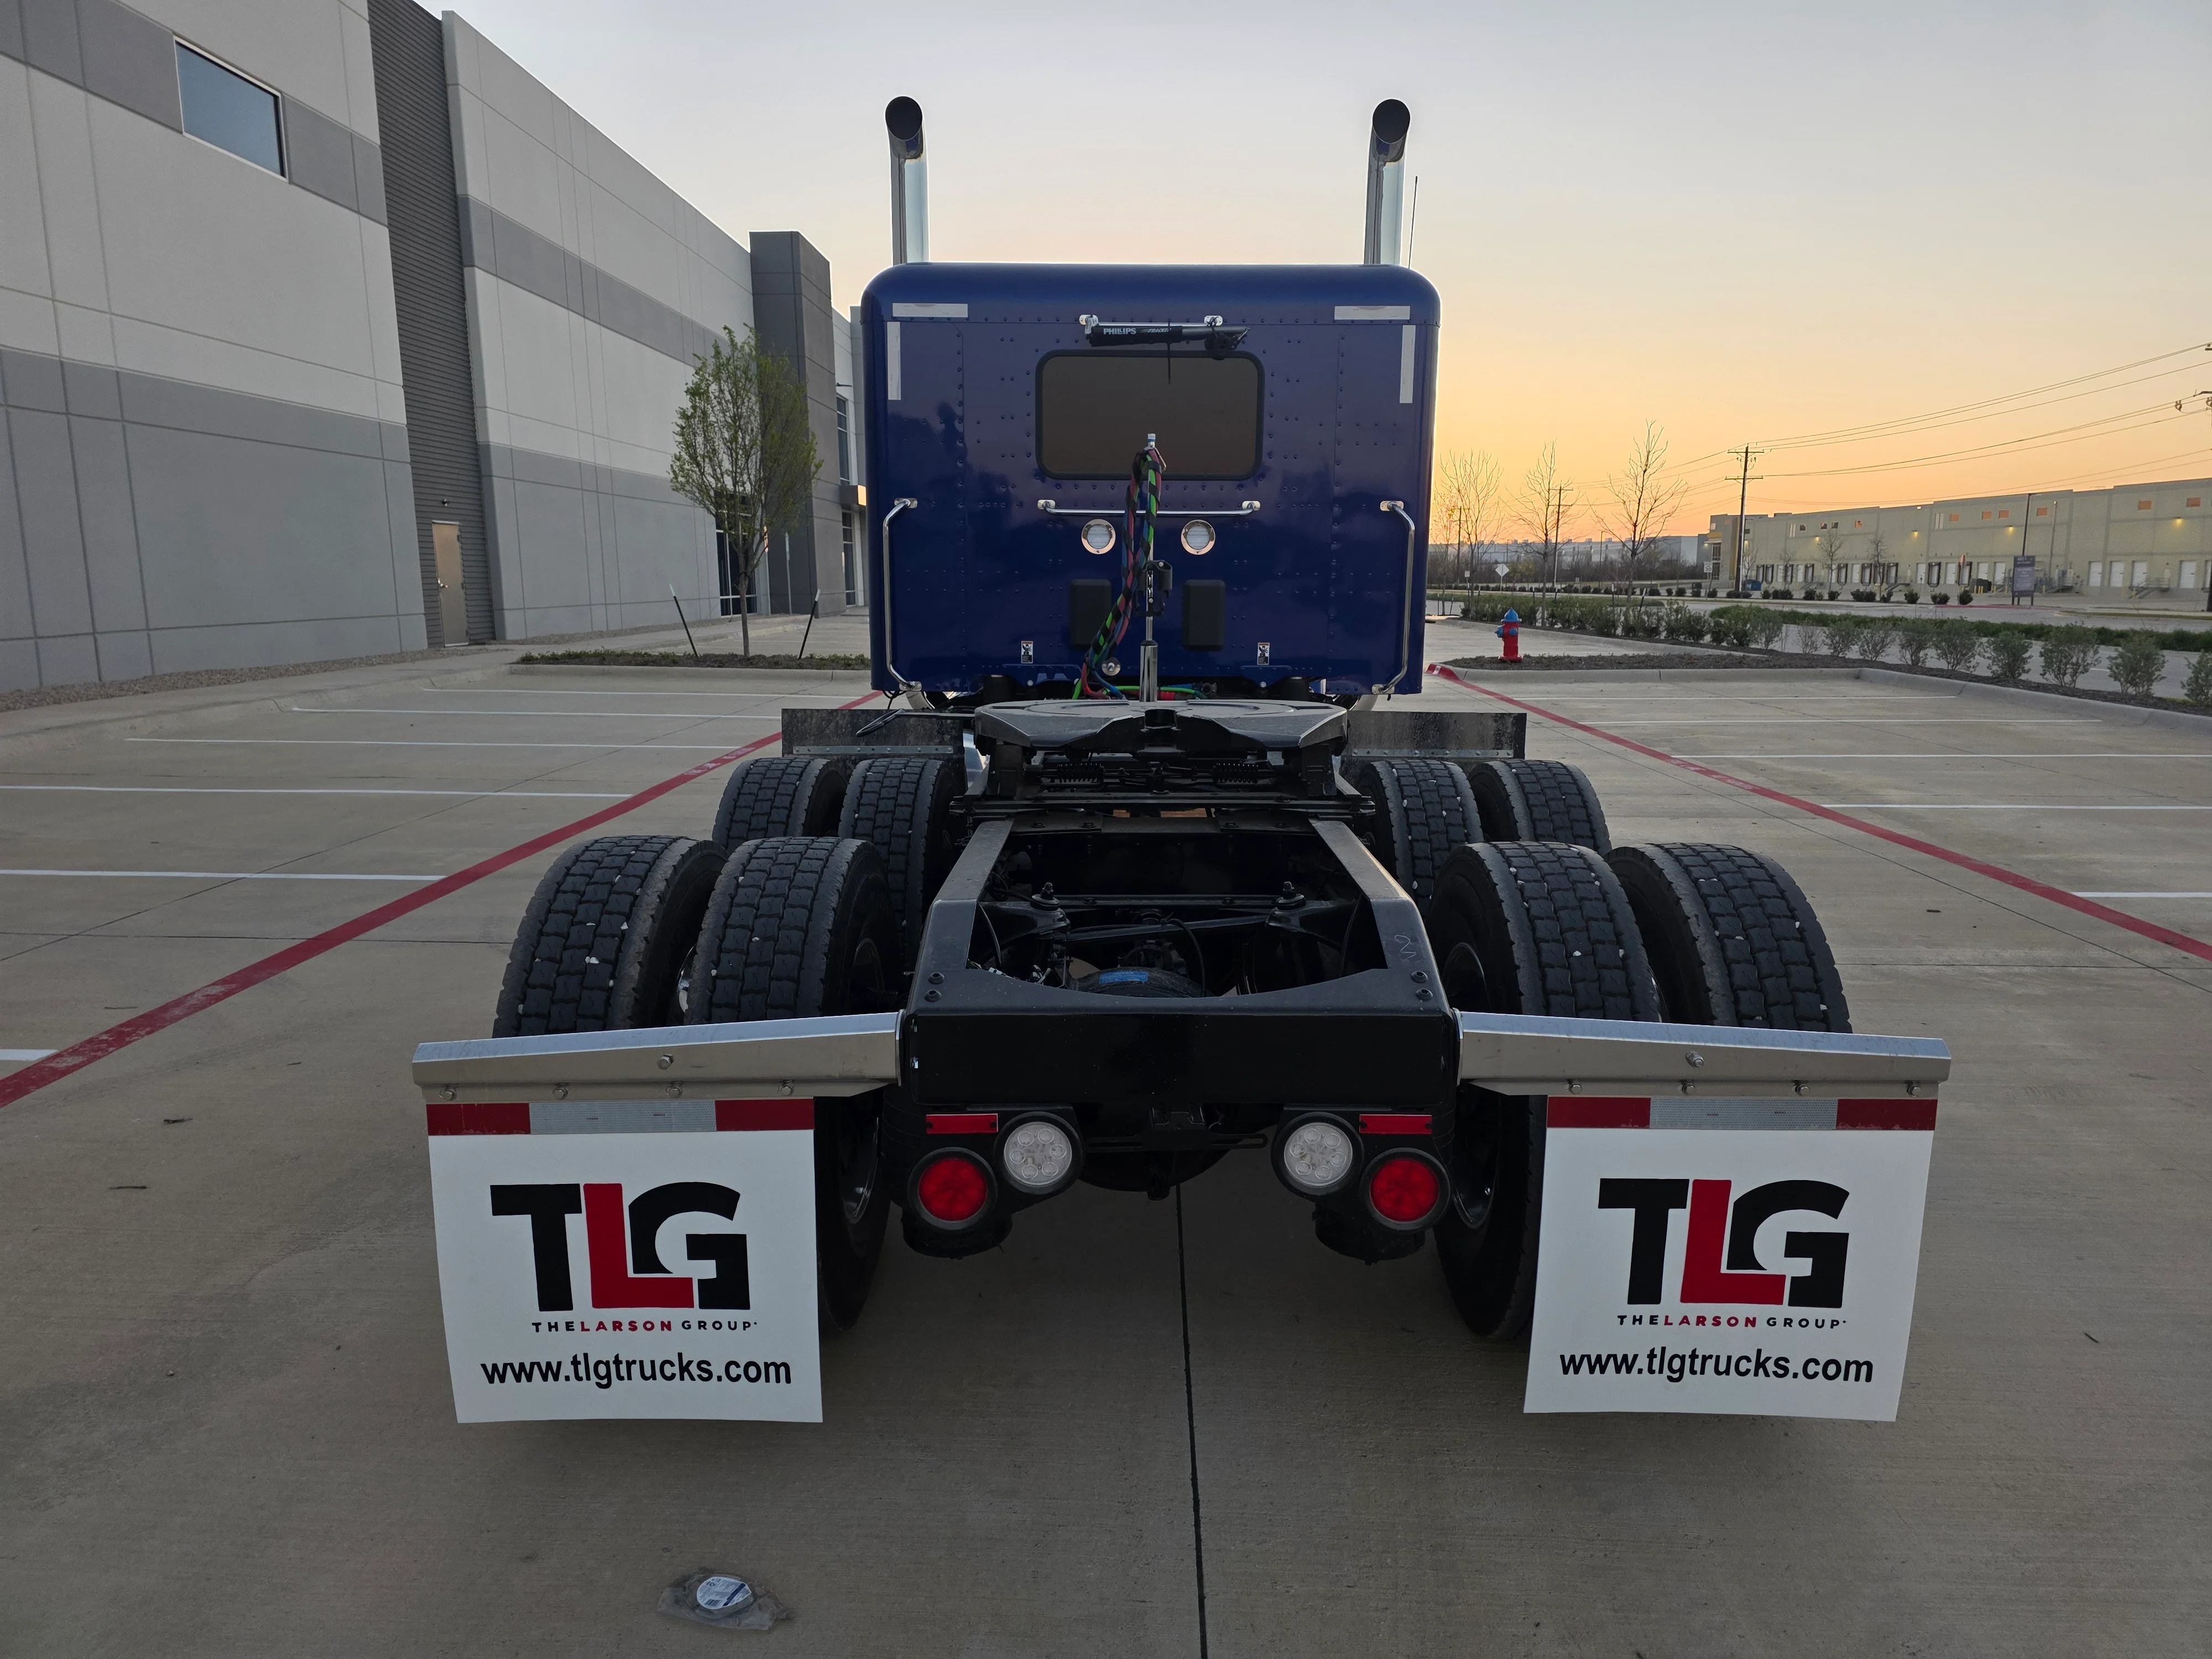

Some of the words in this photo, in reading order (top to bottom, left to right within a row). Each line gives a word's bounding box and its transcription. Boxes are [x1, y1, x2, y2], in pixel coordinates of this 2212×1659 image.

[490, 1182, 750, 1312] TLG
[1598, 1178, 1849, 1308] TLG
[681, 1320, 752, 1331] GROUP
[1766, 1317, 1840, 1329] GROUP
[481, 1353, 791, 1389] www.tlgtrucks.com
[1560, 1347, 1873, 1383] www.tlgtrucks.com
